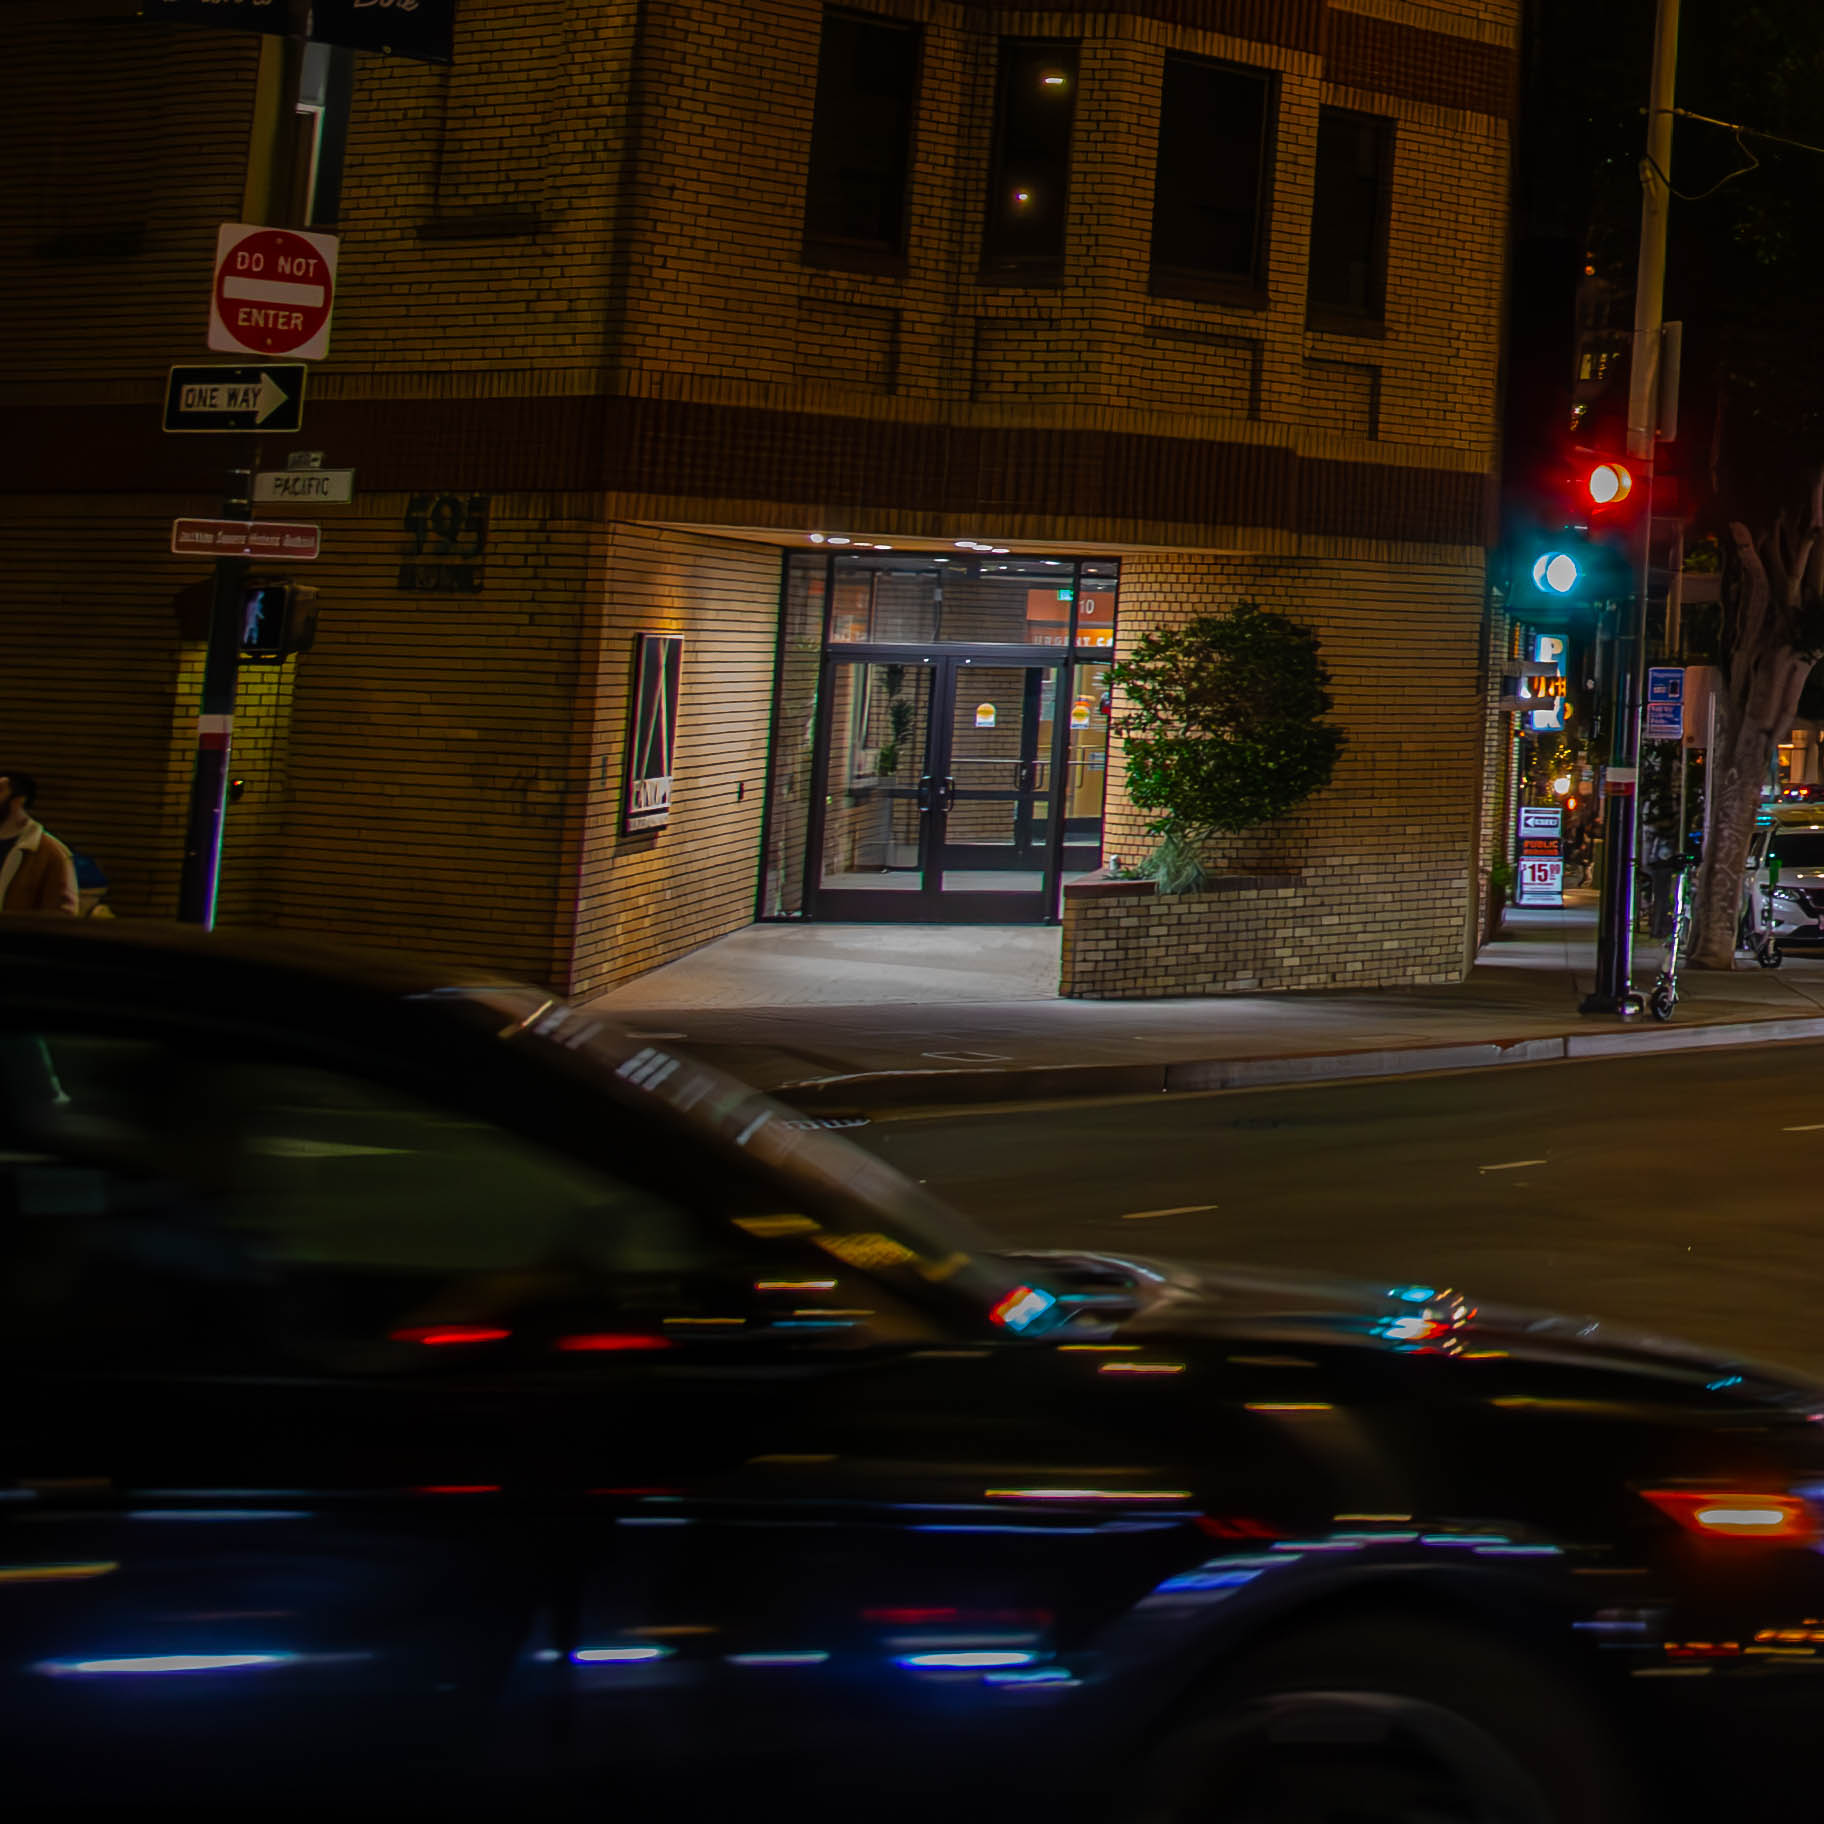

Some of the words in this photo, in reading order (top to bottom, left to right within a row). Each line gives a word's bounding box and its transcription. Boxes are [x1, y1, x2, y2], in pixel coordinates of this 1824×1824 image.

[235, 250, 265, 272] DO
[277, 255, 321, 278] NOT
[237, 306, 304, 332] ENTER
[184, 387, 219, 409] ONE
[226, 387, 263, 409] WAY
[273, 477, 330, 497] PACIFIC
